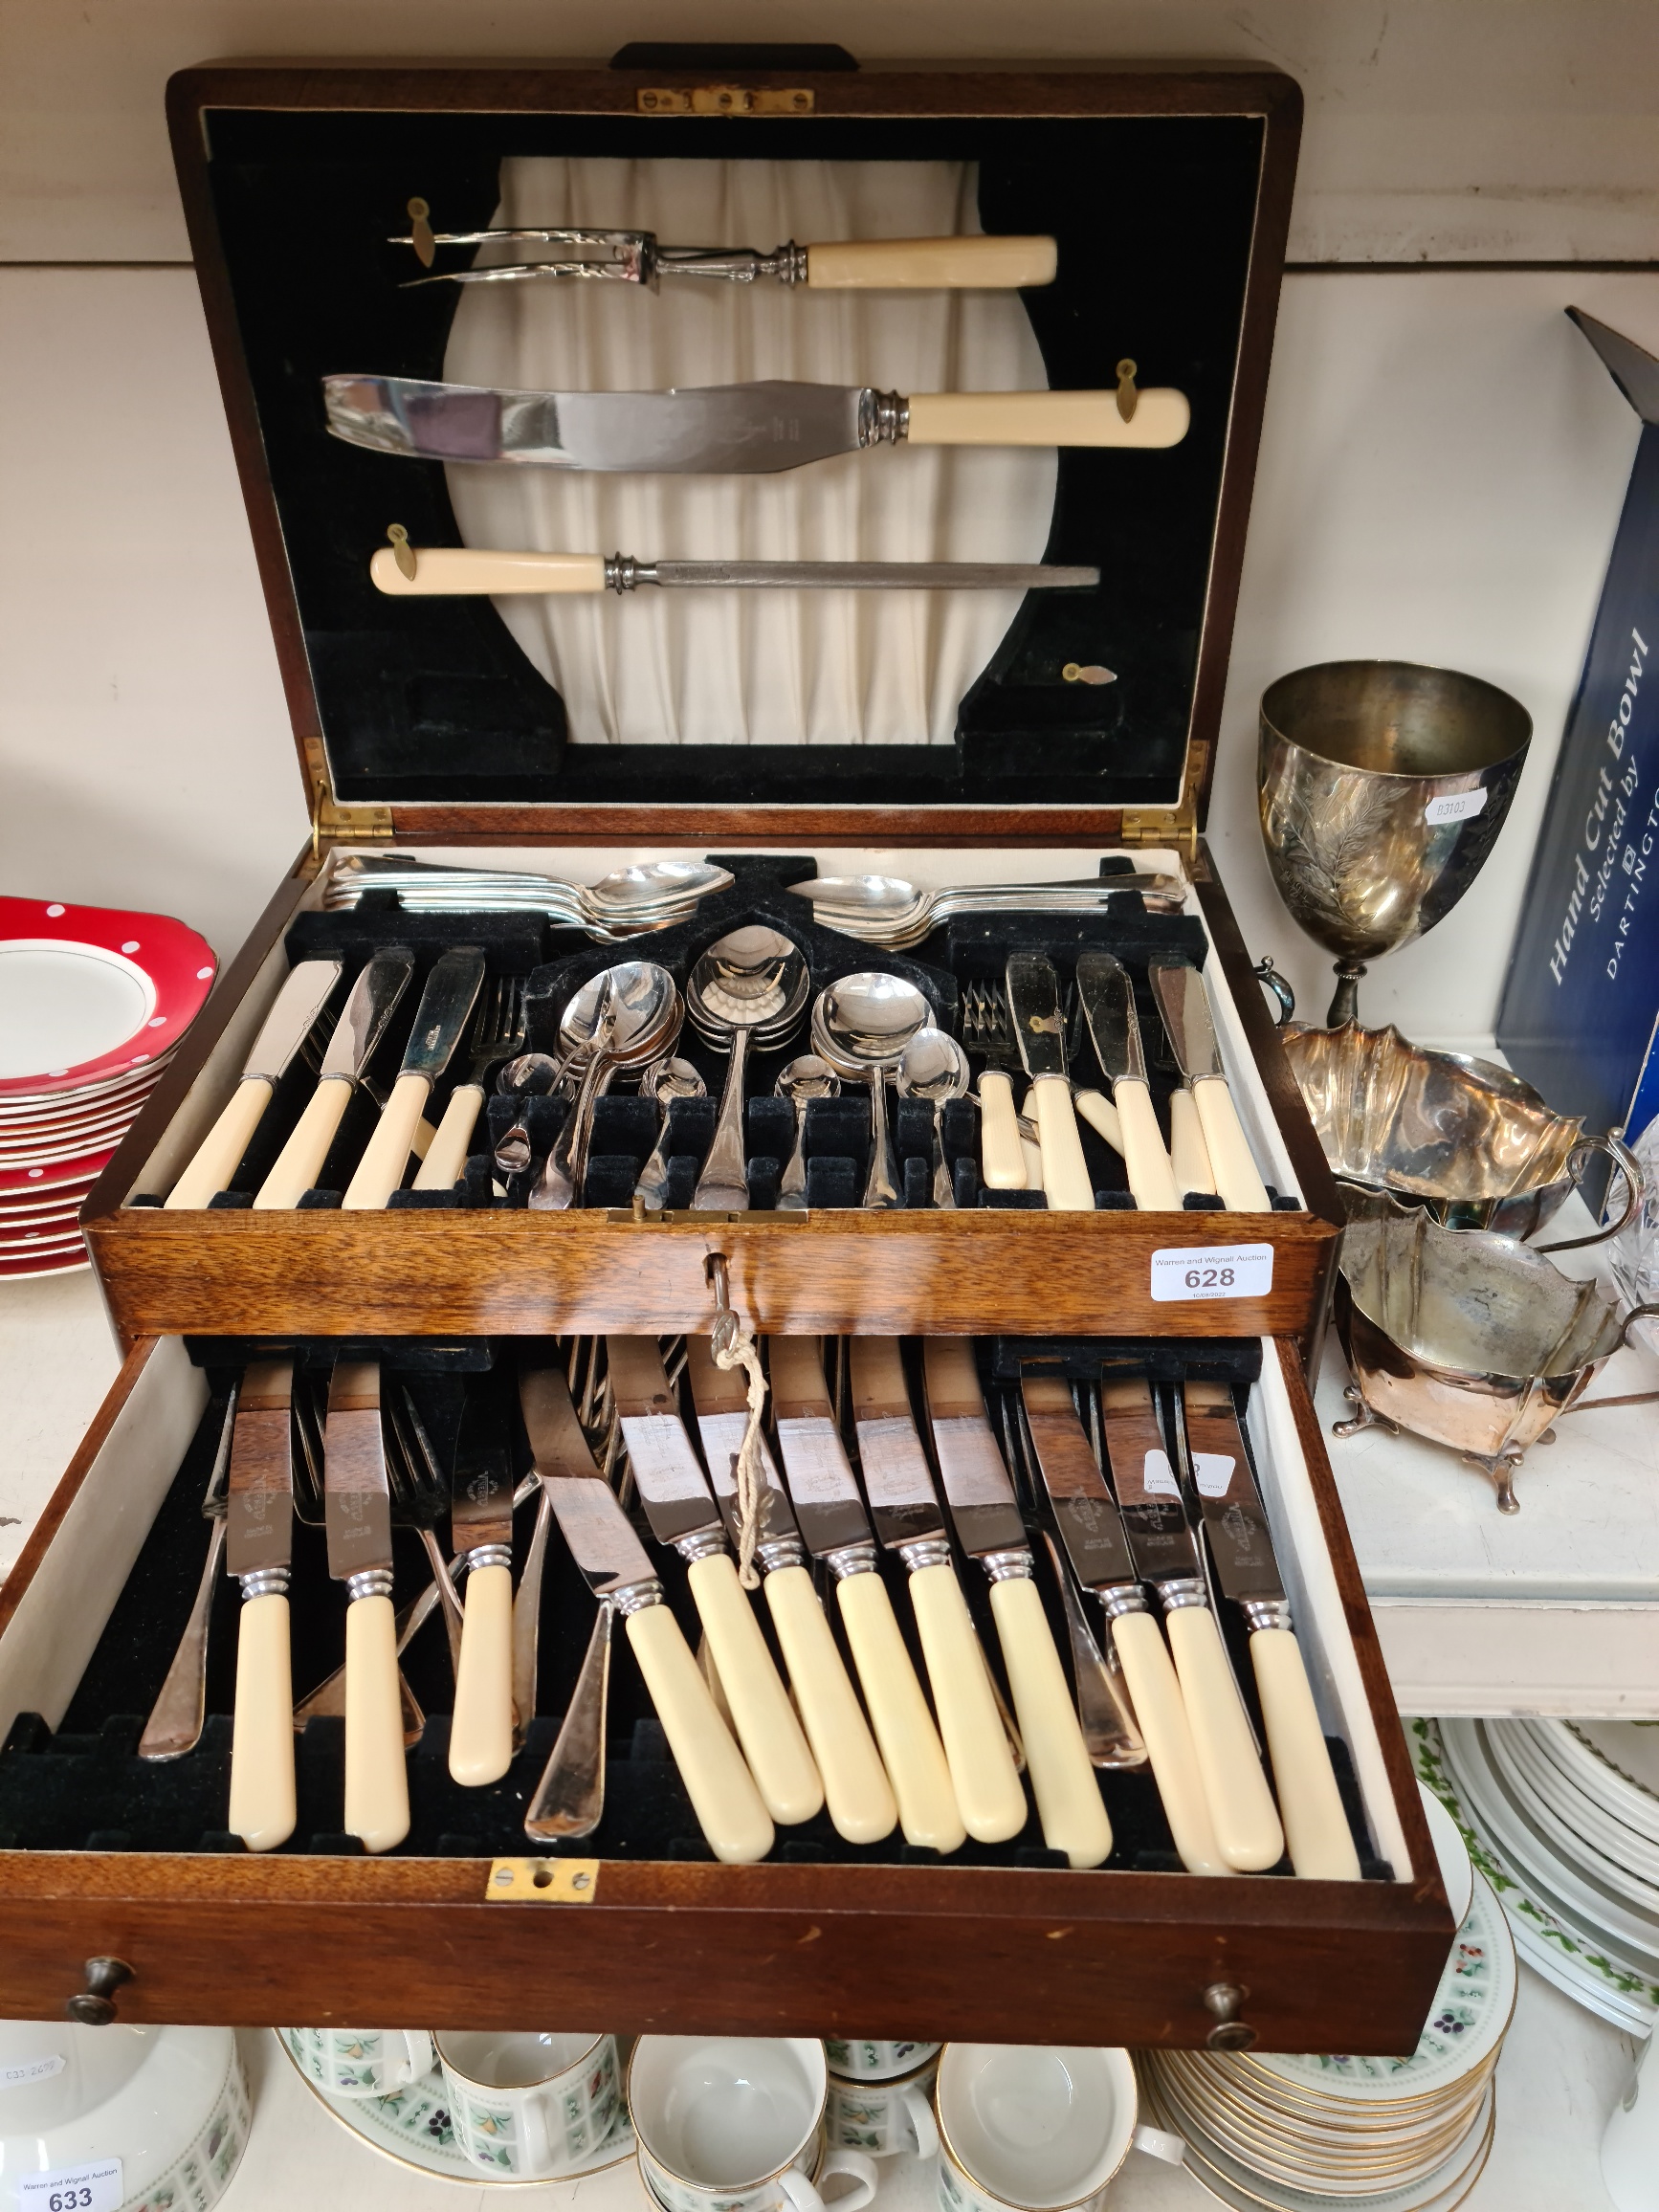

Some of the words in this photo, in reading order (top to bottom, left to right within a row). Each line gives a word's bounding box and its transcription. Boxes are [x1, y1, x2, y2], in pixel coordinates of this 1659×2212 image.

[1550, 852, 1589, 986] Hand
[1585, 766, 1612, 852] Cut
[1607, 627, 1648, 760] Bowl
[1590, 798, 1626, 923] Selected
[1621, 755, 1639, 797] by
[1205, 1255, 1234, 1265] Wignall
[1184, 1268, 1235, 1289] 628
[23, 2181, 49, 2191] Warren
[50, 2179, 63, 2188] and
[64, 2174, 90, 2185] Wignall
[91, 2168, 118, 2179] Auction
[49, 2187, 93, 2212] 633
